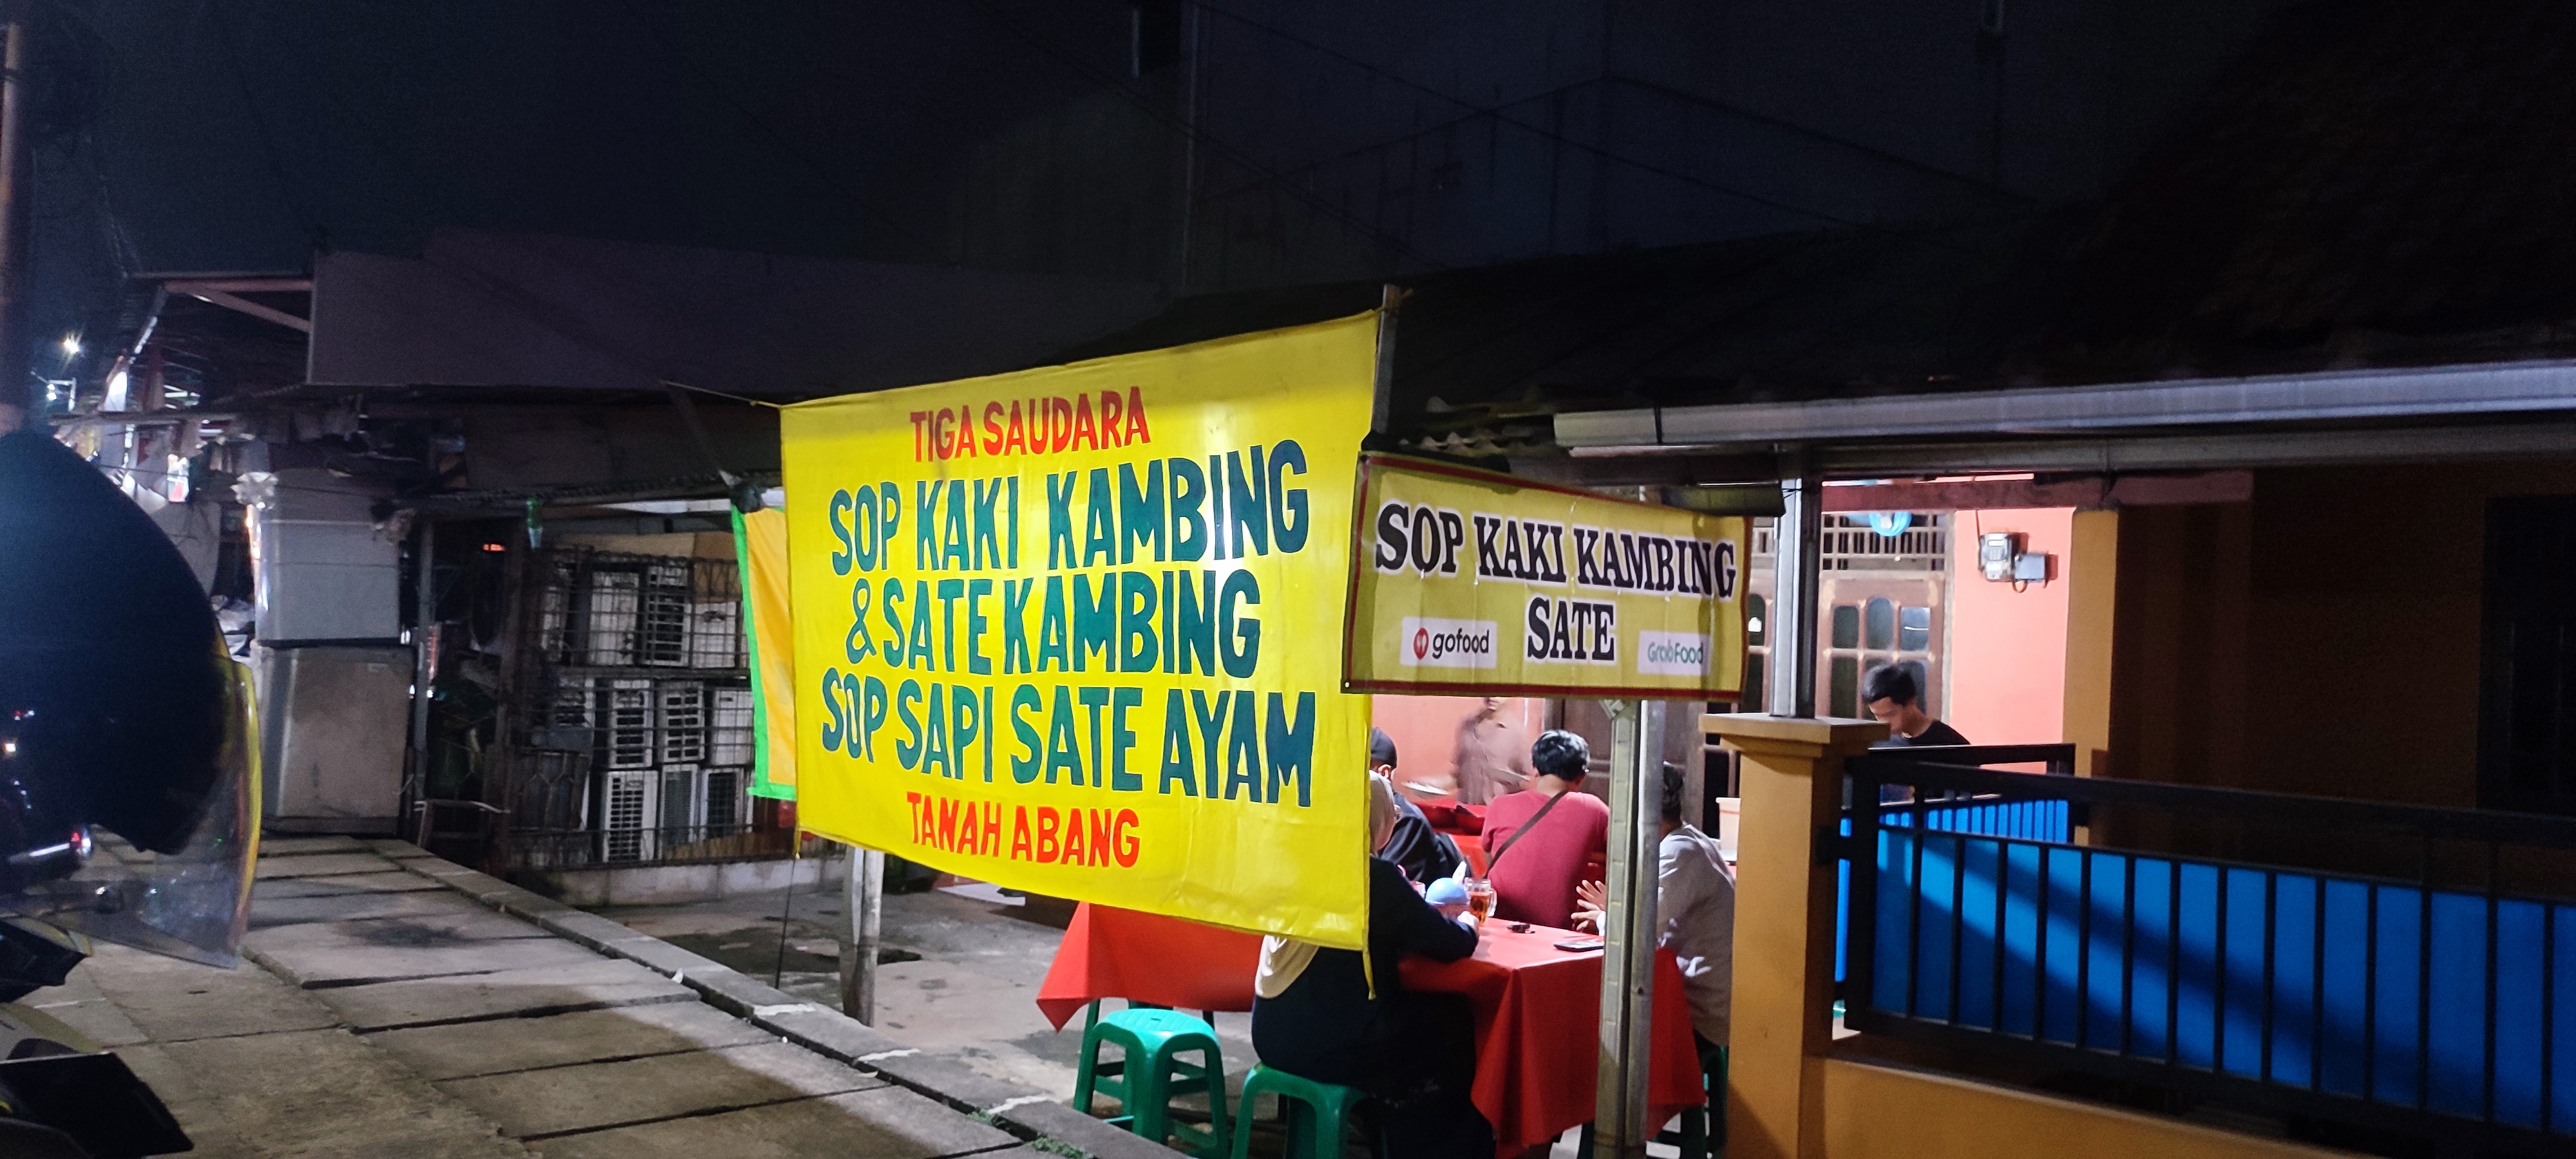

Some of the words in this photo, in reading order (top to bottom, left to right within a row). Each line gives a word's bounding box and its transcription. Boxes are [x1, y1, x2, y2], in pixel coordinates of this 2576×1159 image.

[910, 404, 978, 462] TIGA
[983, 386, 1151, 457] SAUDARA
[829, 481, 901, 576] SOP
[916, 476, 1019, 571] KAKI
[1046, 439, 1309, 570] KAMBING
[1376, 502, 1463, 574] SOP
[1473, 515, 1567, 581] KAKI
[1573, 527, 1737, 598] KAMBING
[845, 577, 876, 664] &
[882, 576, 992, 675] SATE
[1003, 569, 1260, 678] KAMBING
[1432, 628, 1490, 659] gofood
[1528, 598, 1615, 661] SATE
[1647, 639, 1704, 664] GrabFood
[822, 666, 888, 763] SOP
[895, 678, 994, 783] SAPI
[1010, 683, 1143, 792] SATE
[1159, 689, 1316, 807] AYAM
[906, 791, 1002, 858] TANAH
[1010, 805, 1141, 869] ABANG
